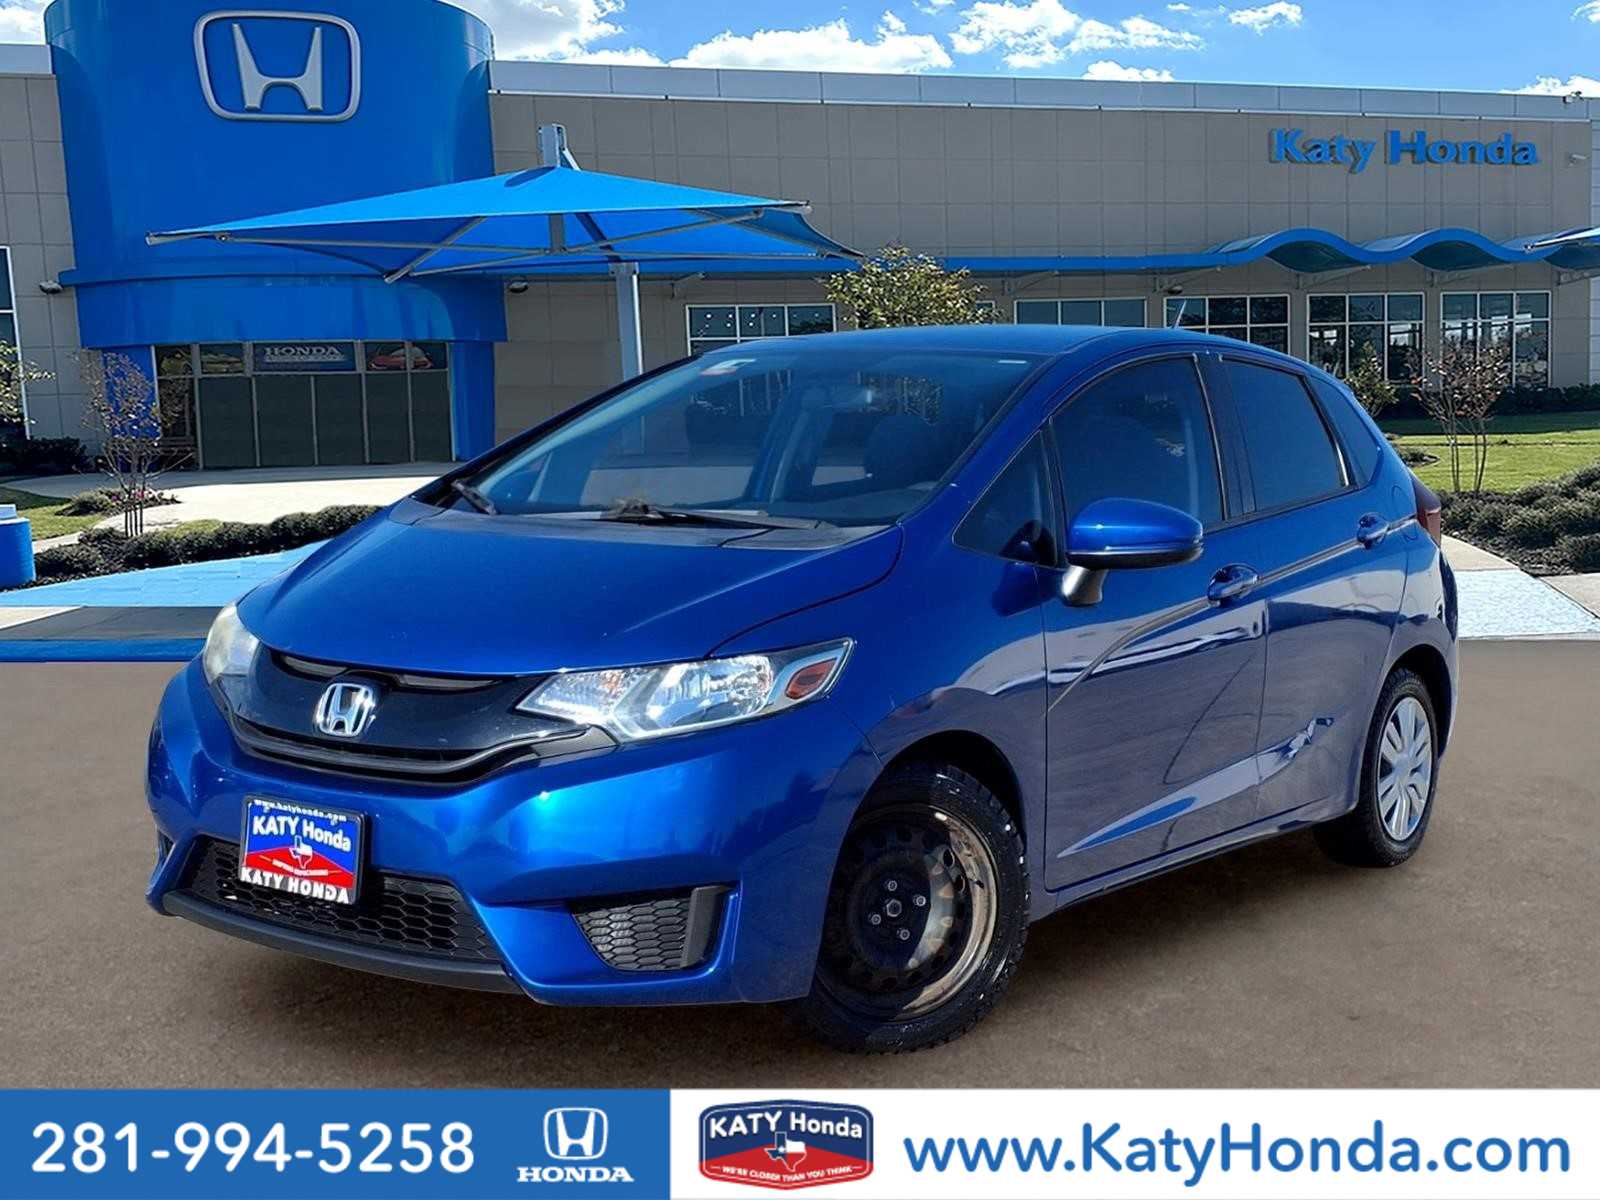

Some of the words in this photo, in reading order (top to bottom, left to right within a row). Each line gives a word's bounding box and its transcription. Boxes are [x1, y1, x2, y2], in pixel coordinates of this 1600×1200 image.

[1269, 127, 1377, 174] Katy
[1385, 129, 1538, 166] Honda
[264, 346, 342, 357] HONDA
[252, 815, 300, 836] KATY
[302, 818, 351, 852] Honda
[240, 866, 286, 890] KATY
[287, 876, 349, 905] HONDA
